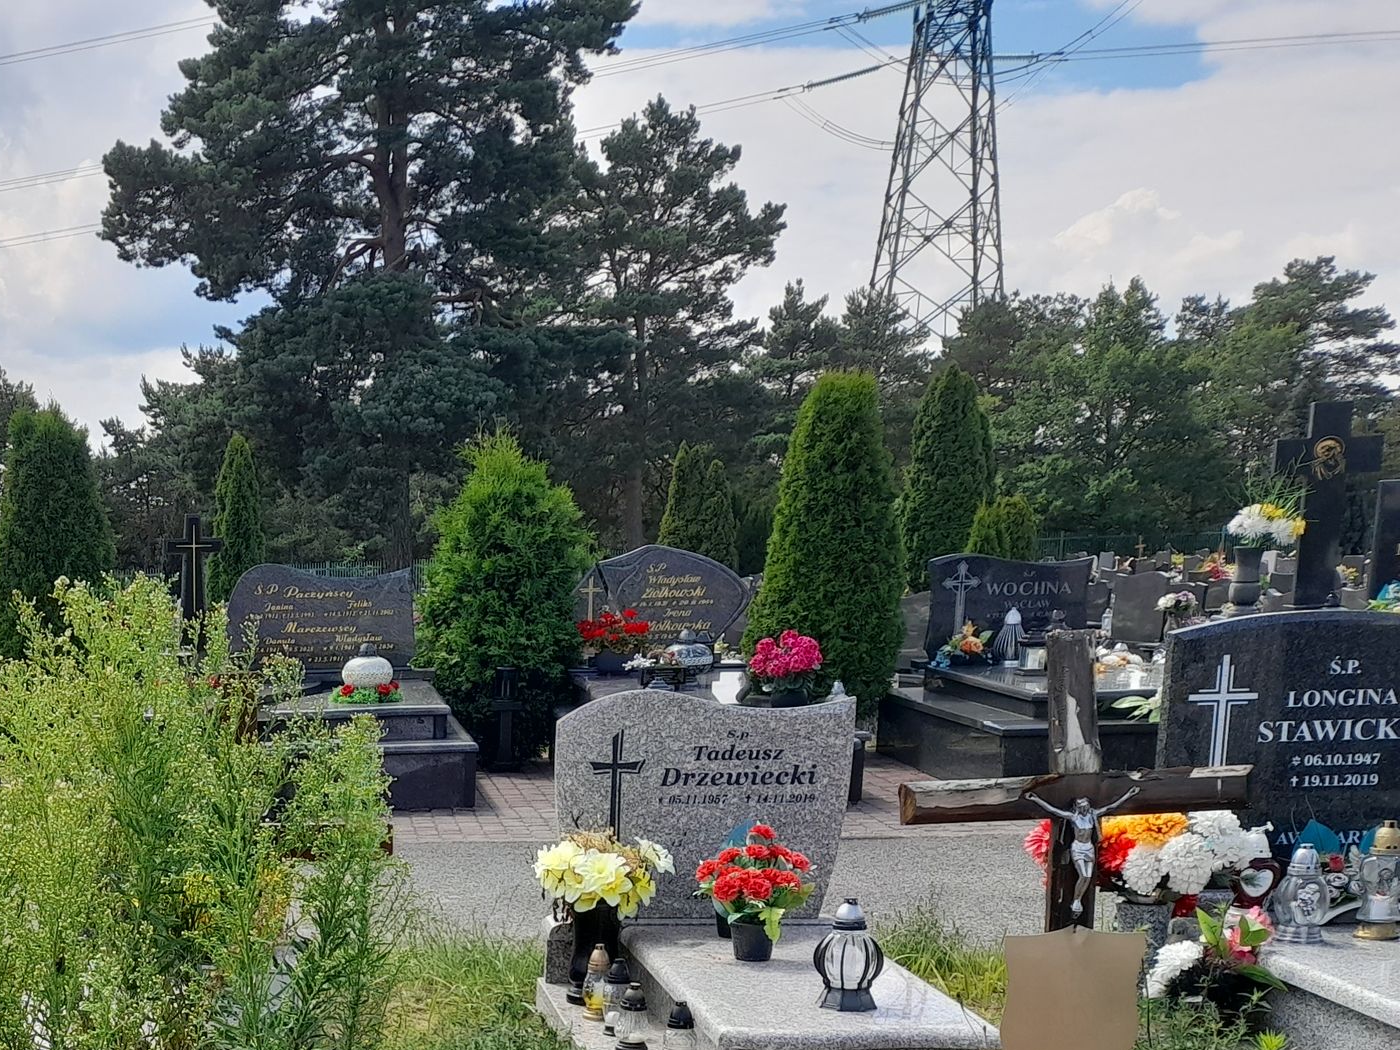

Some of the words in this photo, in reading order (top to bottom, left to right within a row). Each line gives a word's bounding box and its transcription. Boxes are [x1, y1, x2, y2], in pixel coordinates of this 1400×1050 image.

[1286, 688, 1399, 708] LONGINA
[694, 744, 785, 762] Tadeusz
[1304, 752, 1380, 767] 06.10.1947
[661, 763, 818, 787] Drzewiecki
[1302, 773, 1379, 788] 19.11.2019
